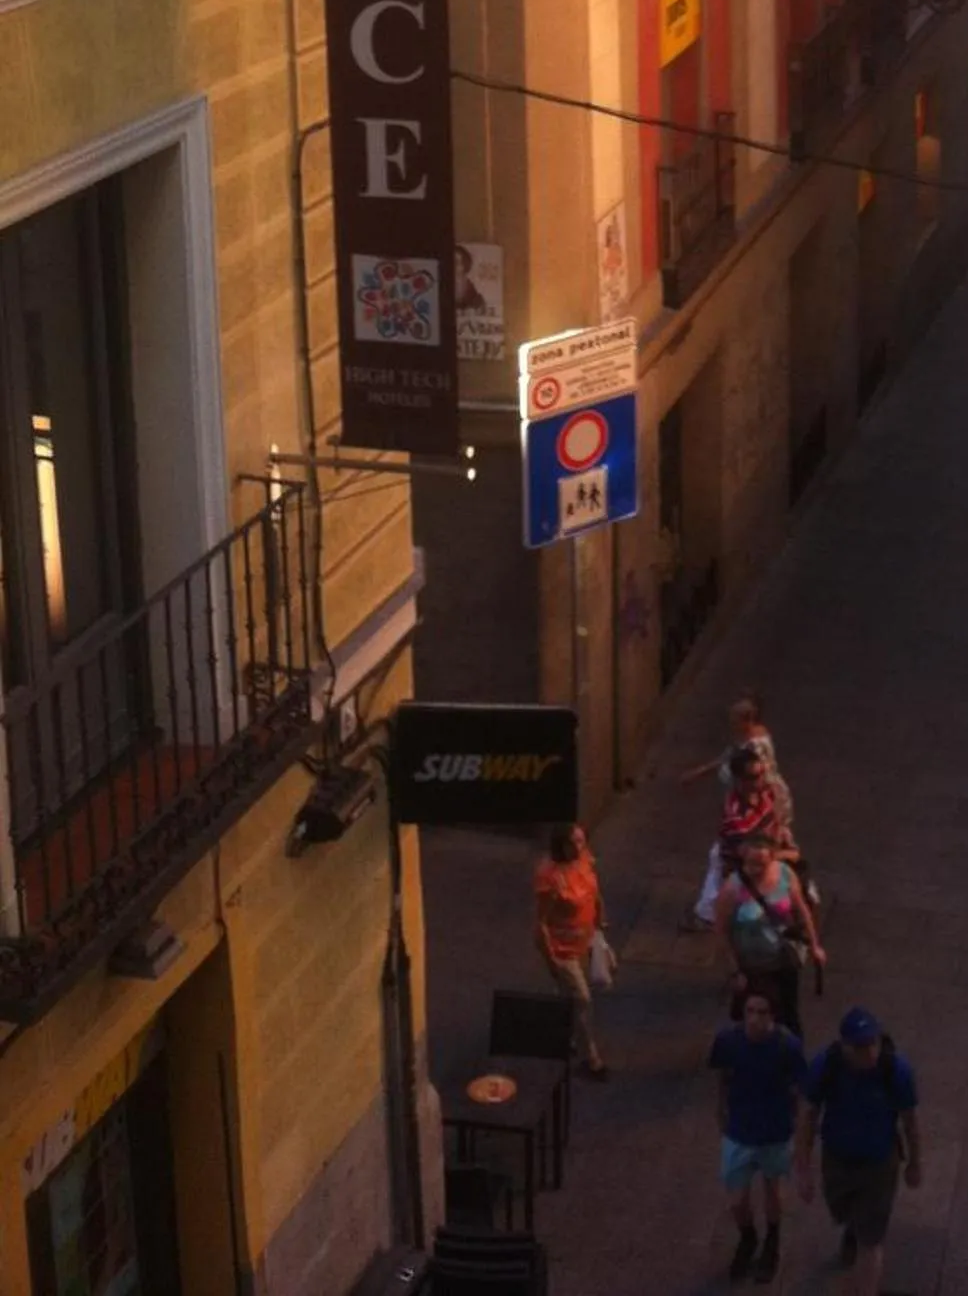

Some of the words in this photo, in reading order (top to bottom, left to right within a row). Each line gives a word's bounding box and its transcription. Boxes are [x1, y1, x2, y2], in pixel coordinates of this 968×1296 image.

[344, 365, 395, 386] HIGH
[400, 369, 451, 391] TECH
[414, 754, 562, 782] SUBWAY
